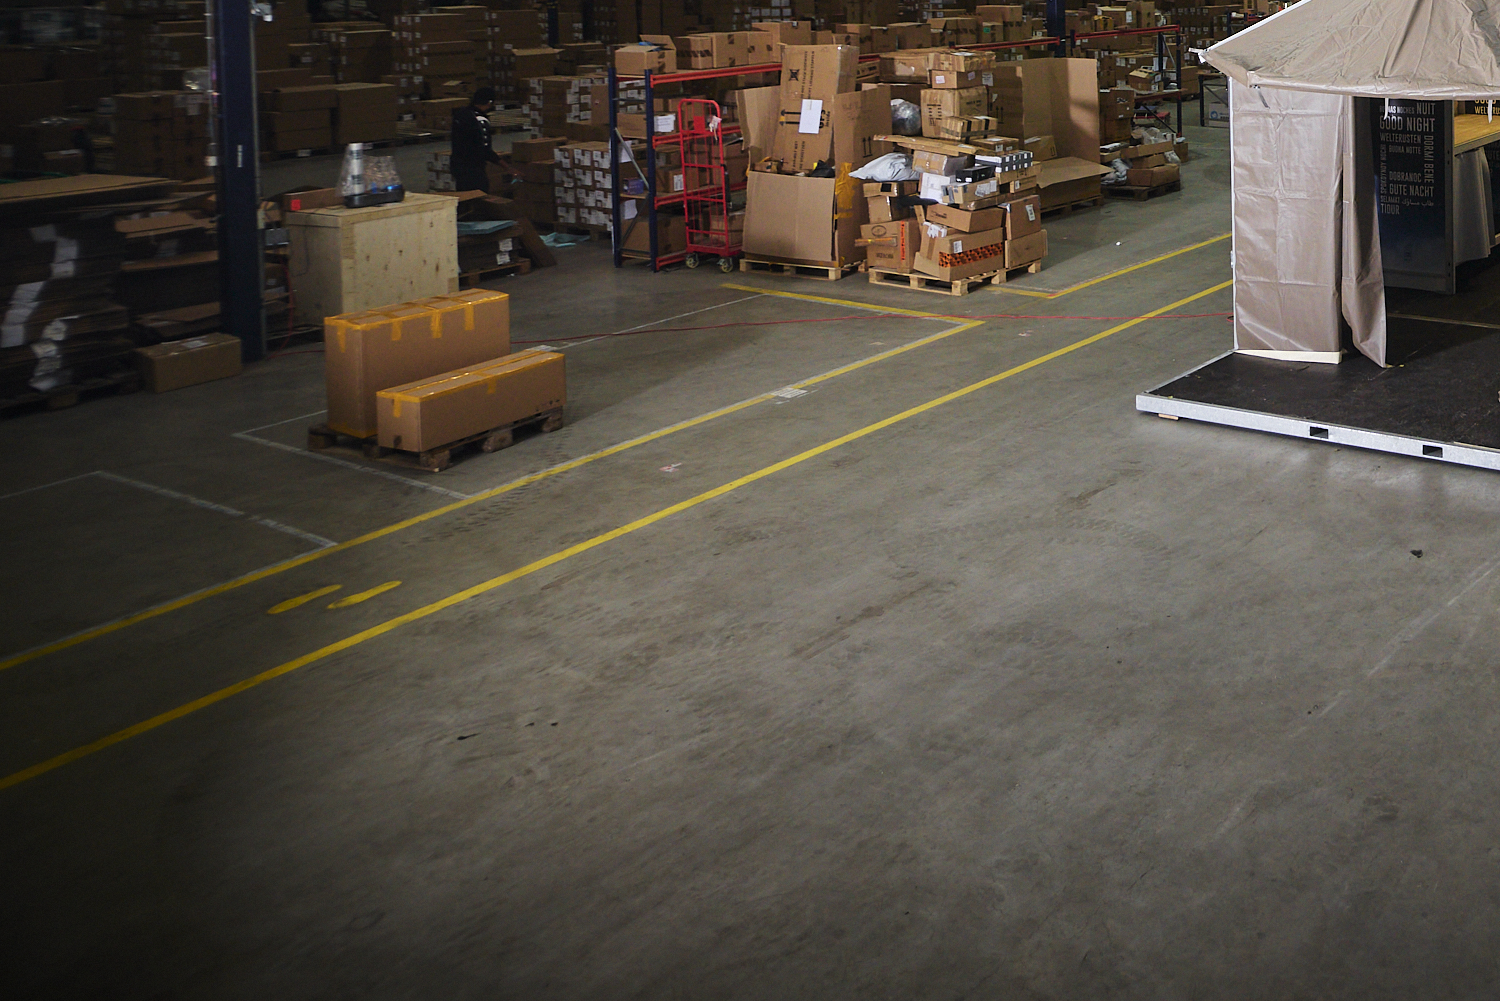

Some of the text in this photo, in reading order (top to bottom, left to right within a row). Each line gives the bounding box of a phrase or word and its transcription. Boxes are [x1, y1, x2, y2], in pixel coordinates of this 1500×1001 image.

[1416, 102, 1436, 115] NUIT
[1380, 115, 1436, 132] GOOD NIGHT
[1380, 132, 1422, 144] WELTERUSTEN
[1423, 135, 1434, 184] DORMI BENE
[1389, 171, 1422, 183] DOBRANOC
[1390, 183, 1434, 197] GUTE NACHT
